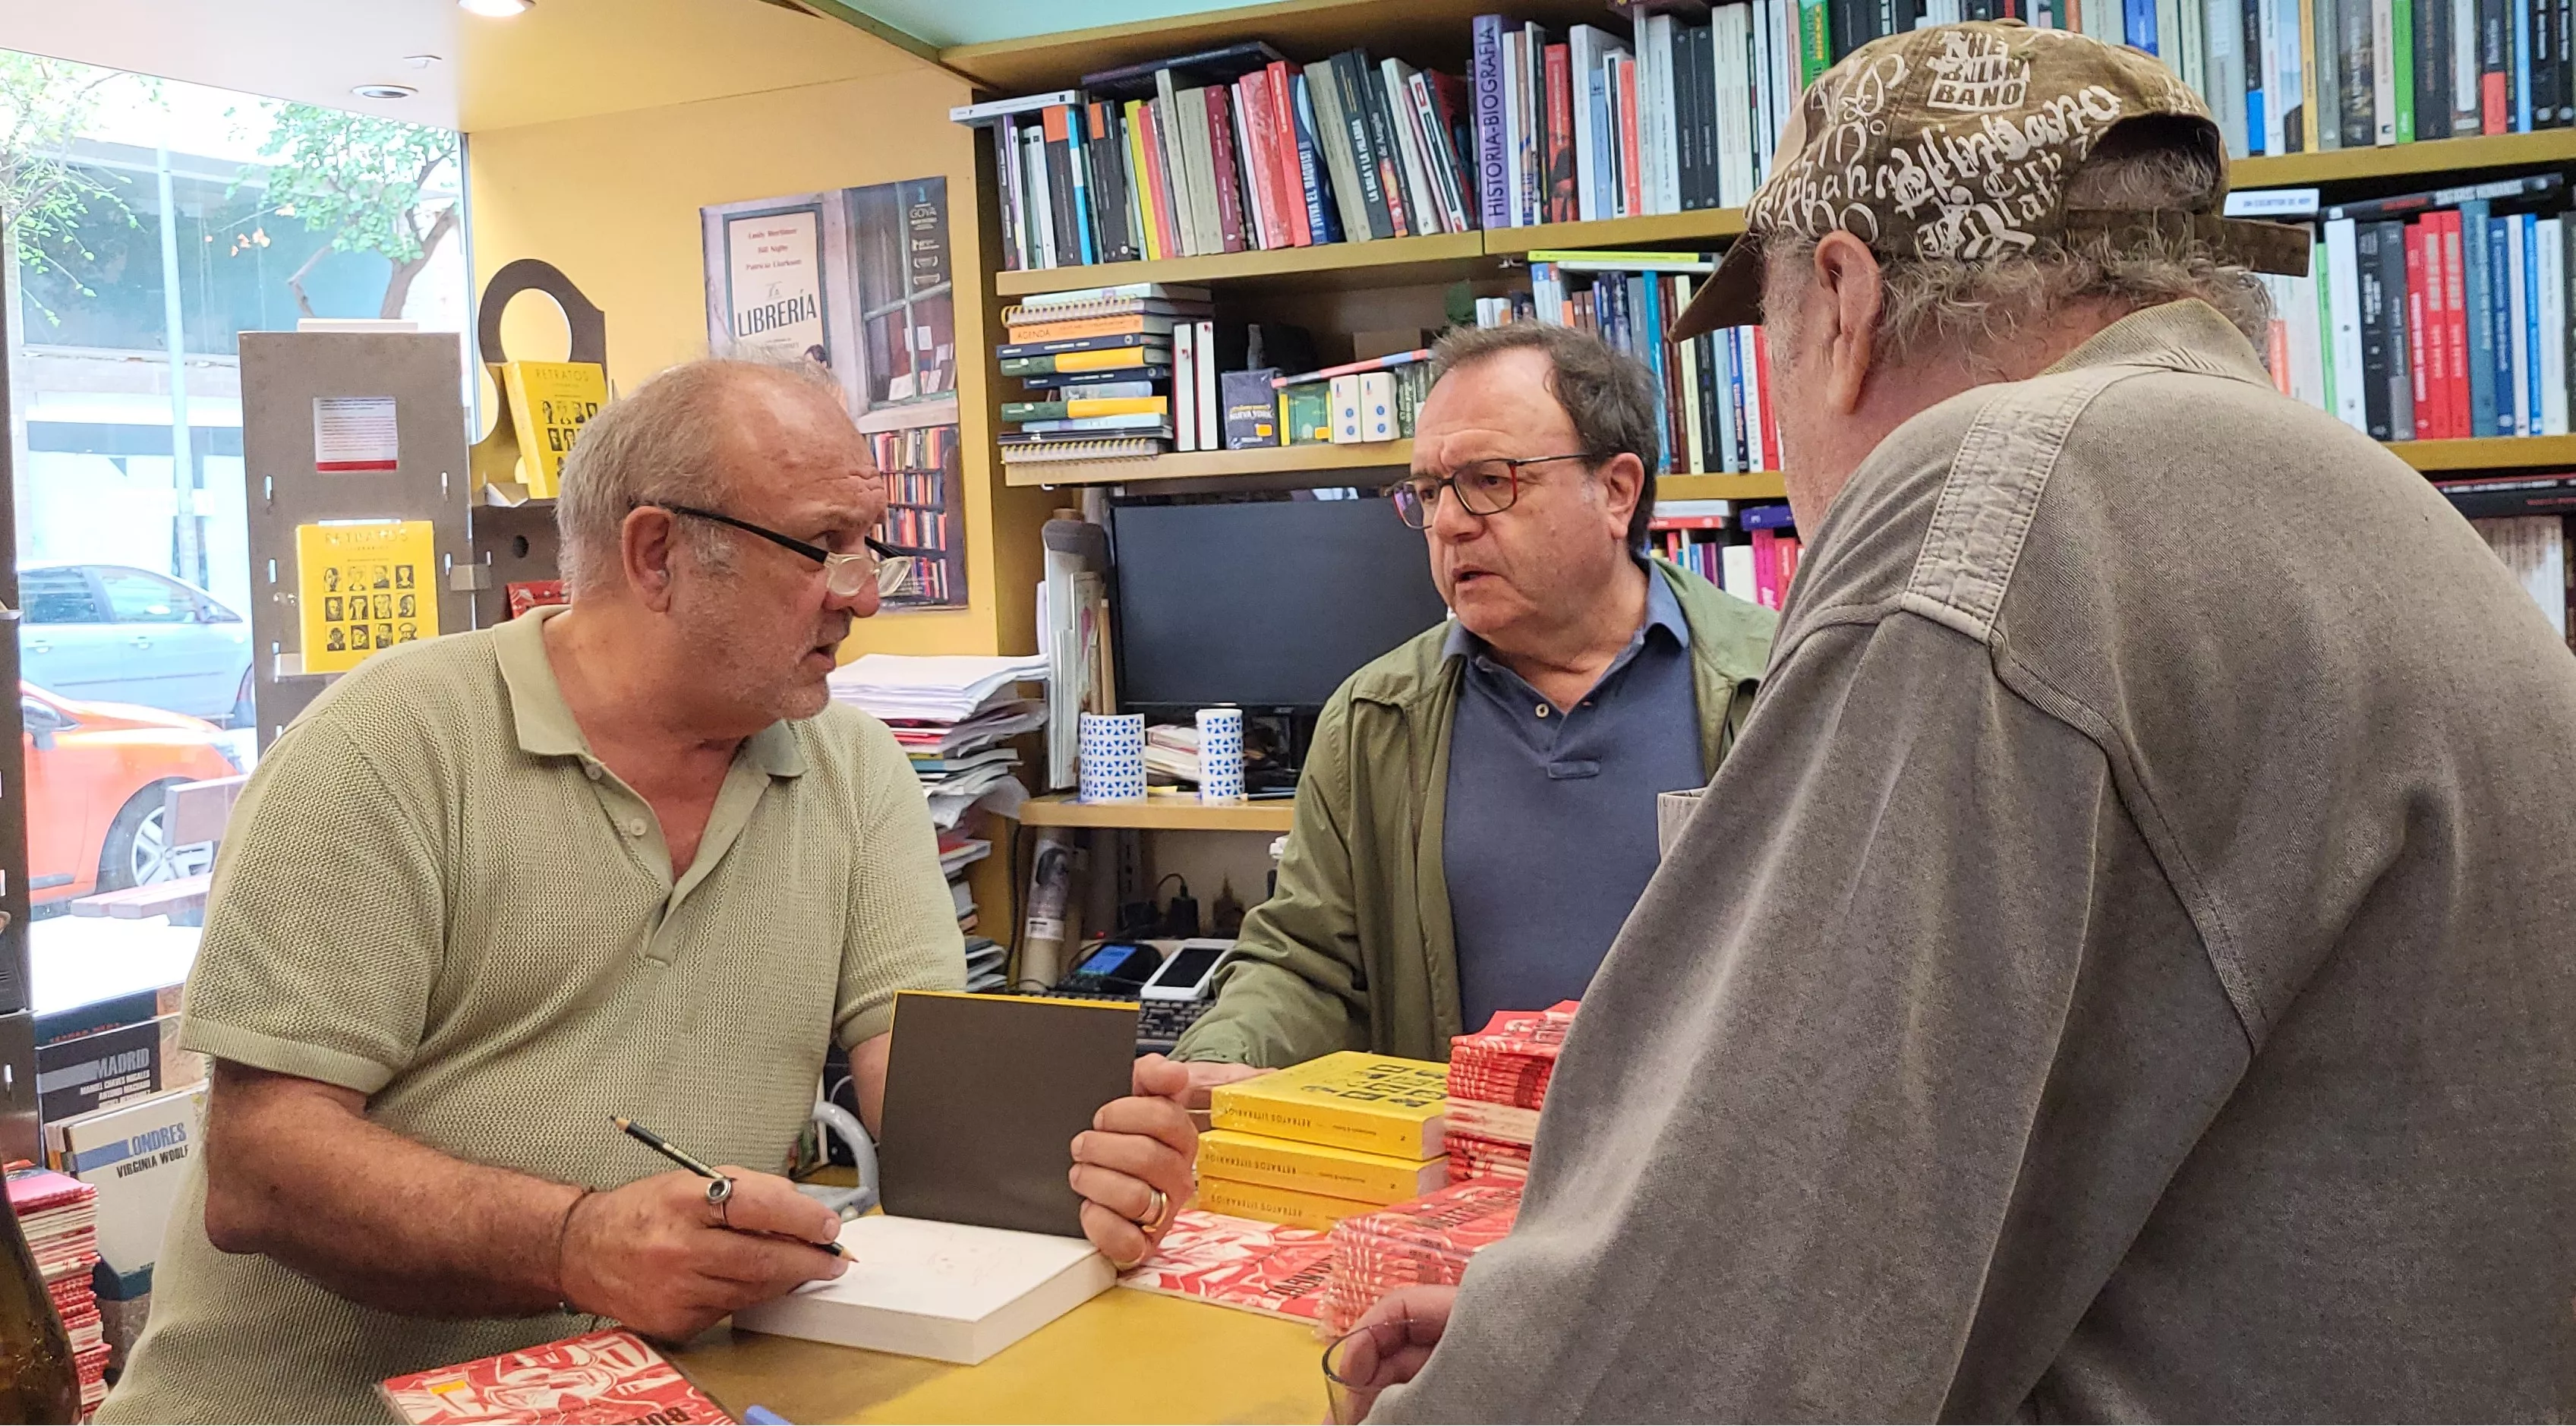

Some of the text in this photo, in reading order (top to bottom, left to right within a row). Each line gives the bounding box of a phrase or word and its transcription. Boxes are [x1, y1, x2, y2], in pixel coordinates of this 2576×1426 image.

[1479, 26, 1506, 217] HISTORIA-BIOGRAFIA
[737, 289, 818, 337] LIBRERÍA
[1017, 329, 1052, 341] AGENDA
[534, 368, 590, 383] RETRATOS
[97, 1048, 150, 1080] MADRID
[1272, 1112, 1312, 1128] RETRATOS
[128, 1122, 188, 1158] LONDRES
[116, 1144, 189, 1178] VIRGINIA WOOLF
[1254, 1158, 1297, 1175] RETRATOS
[1260, 1200, 1303, 1218] RETRATOS
